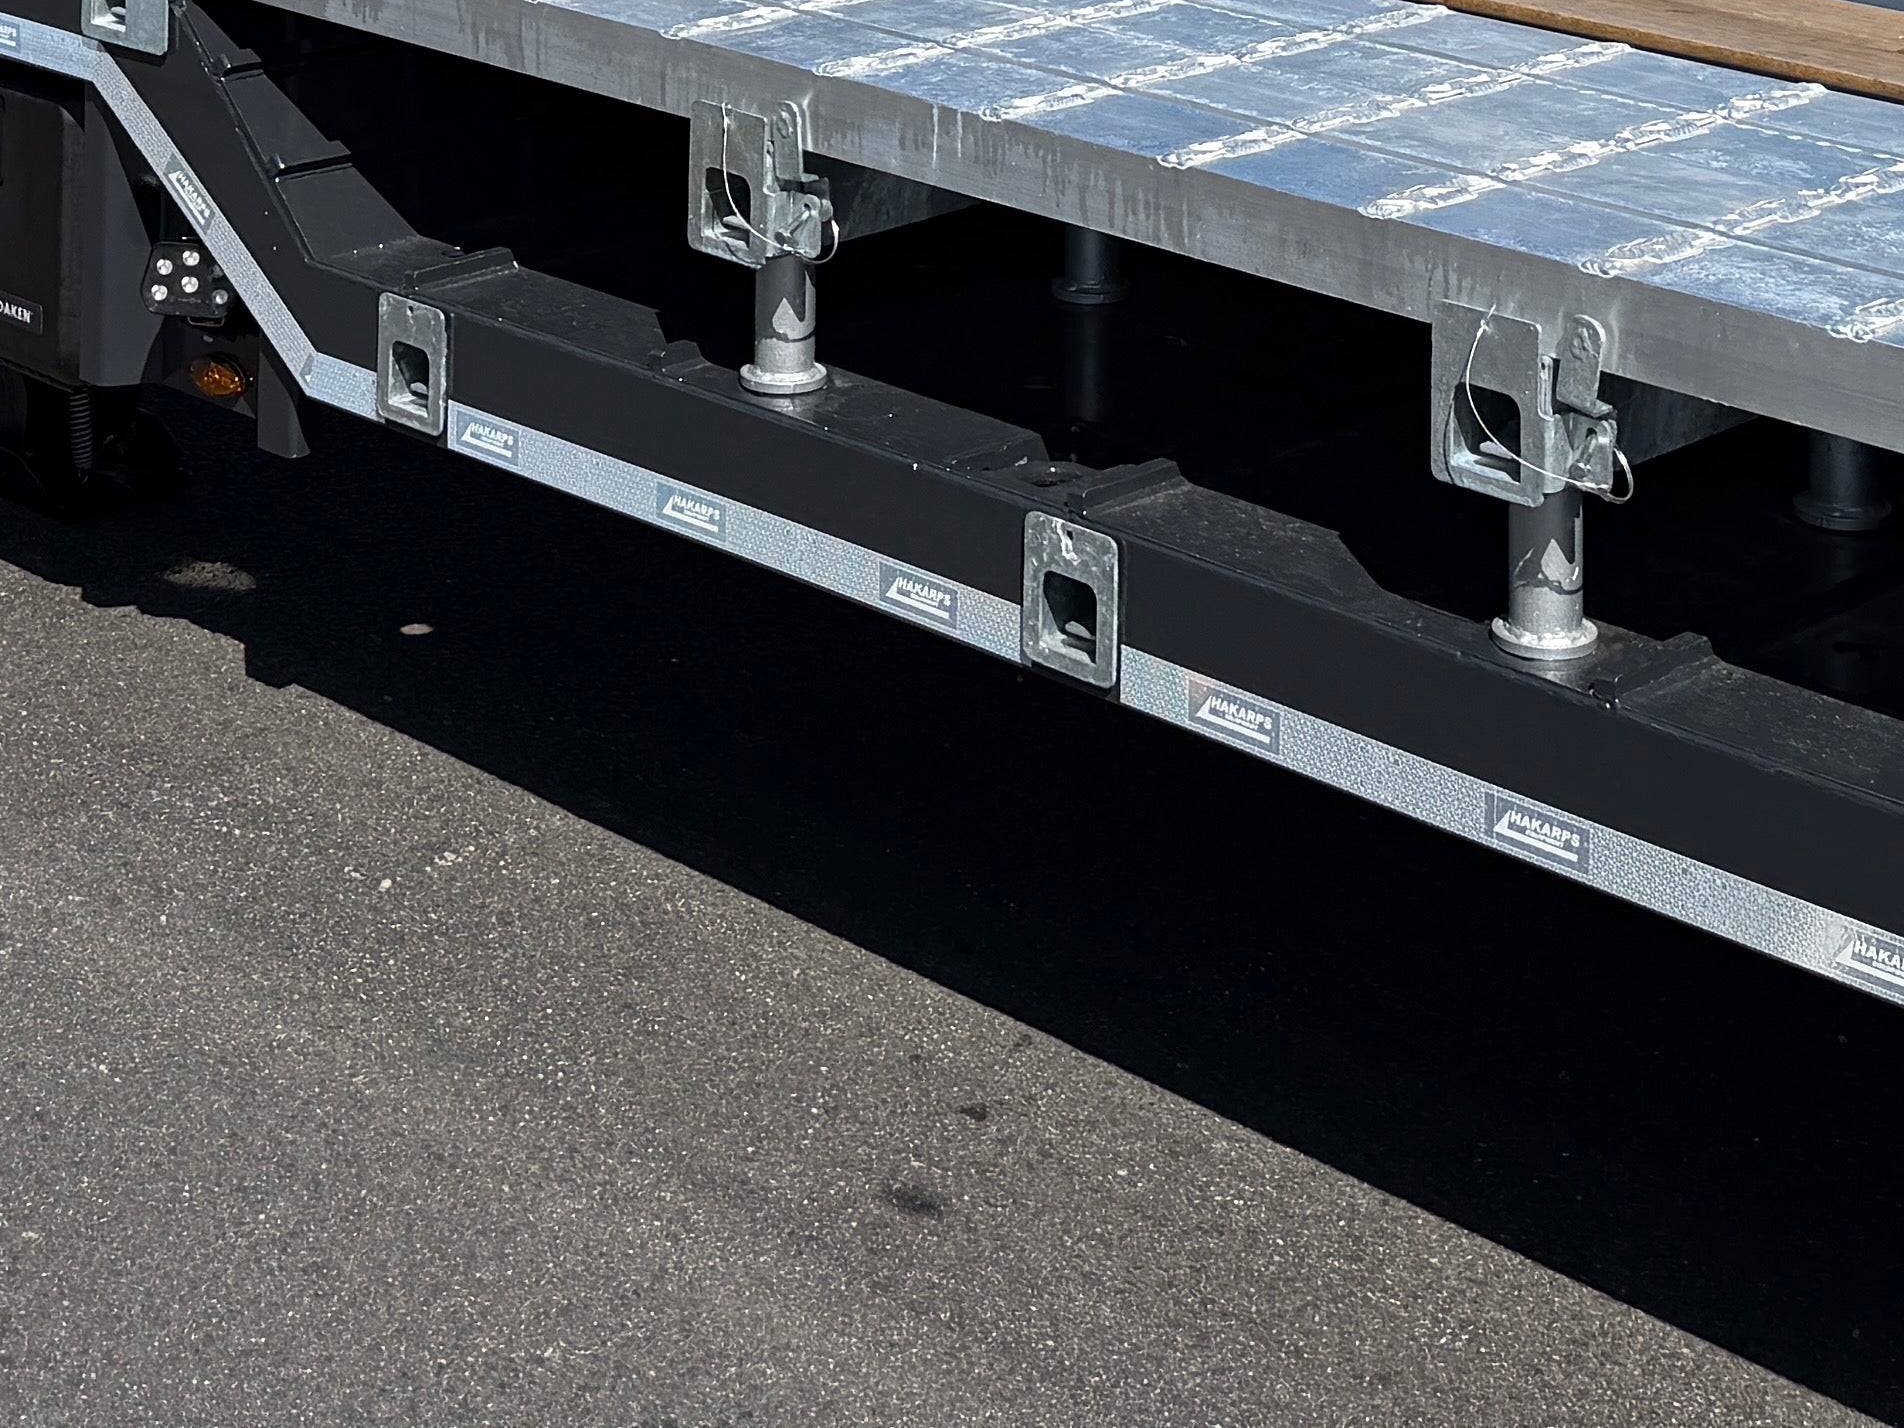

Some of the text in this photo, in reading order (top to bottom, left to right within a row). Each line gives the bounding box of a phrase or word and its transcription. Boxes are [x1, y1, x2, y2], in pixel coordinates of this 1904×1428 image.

[898, 576, 951, 606] HAKARPS
[1211, 696, 1273, 730] HAKARPS
[1509, 810, 1580, 847] HAKARPS
